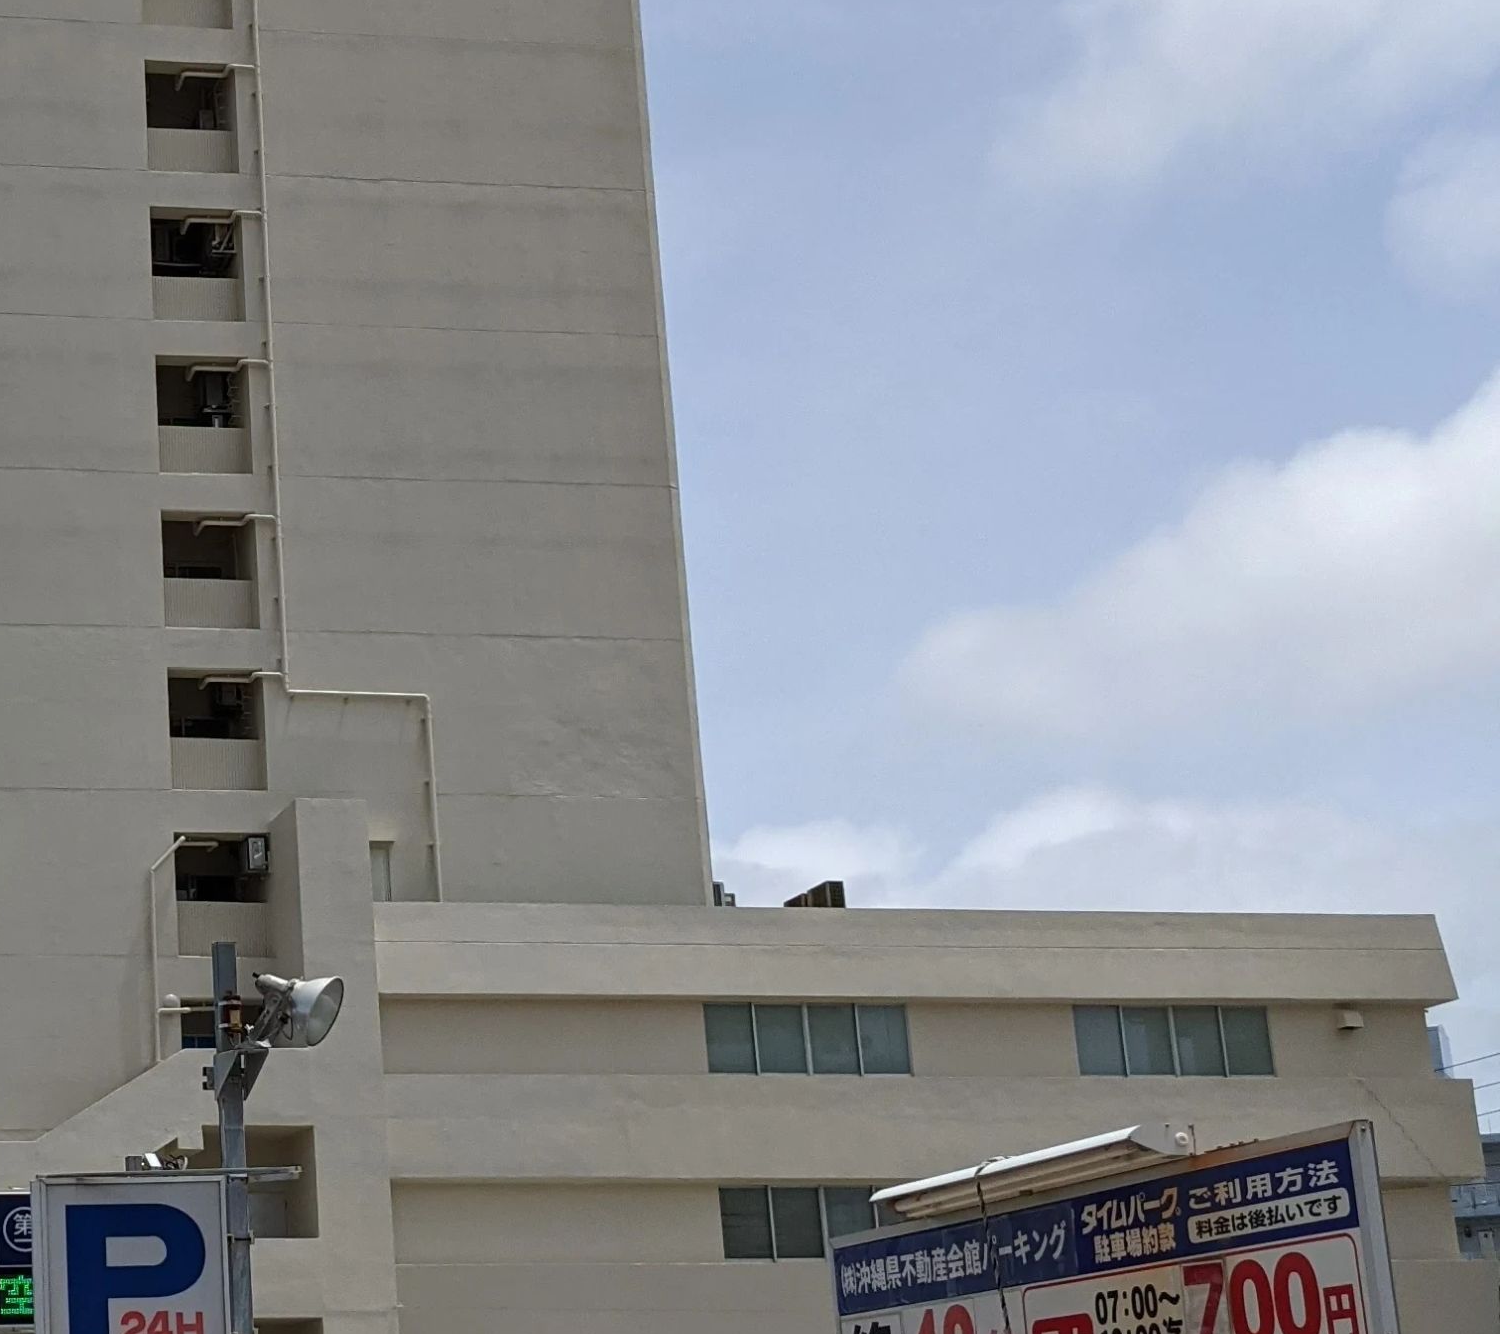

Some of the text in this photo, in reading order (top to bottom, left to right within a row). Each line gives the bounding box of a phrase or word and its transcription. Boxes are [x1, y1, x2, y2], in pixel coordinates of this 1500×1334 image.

[1189, 1159, 1339, 1209] ご利用方法
[1195, 1194, 1342, 1238] 料金は後払いです
[1094, 1221, 1177, 1264] 駐車場約款
